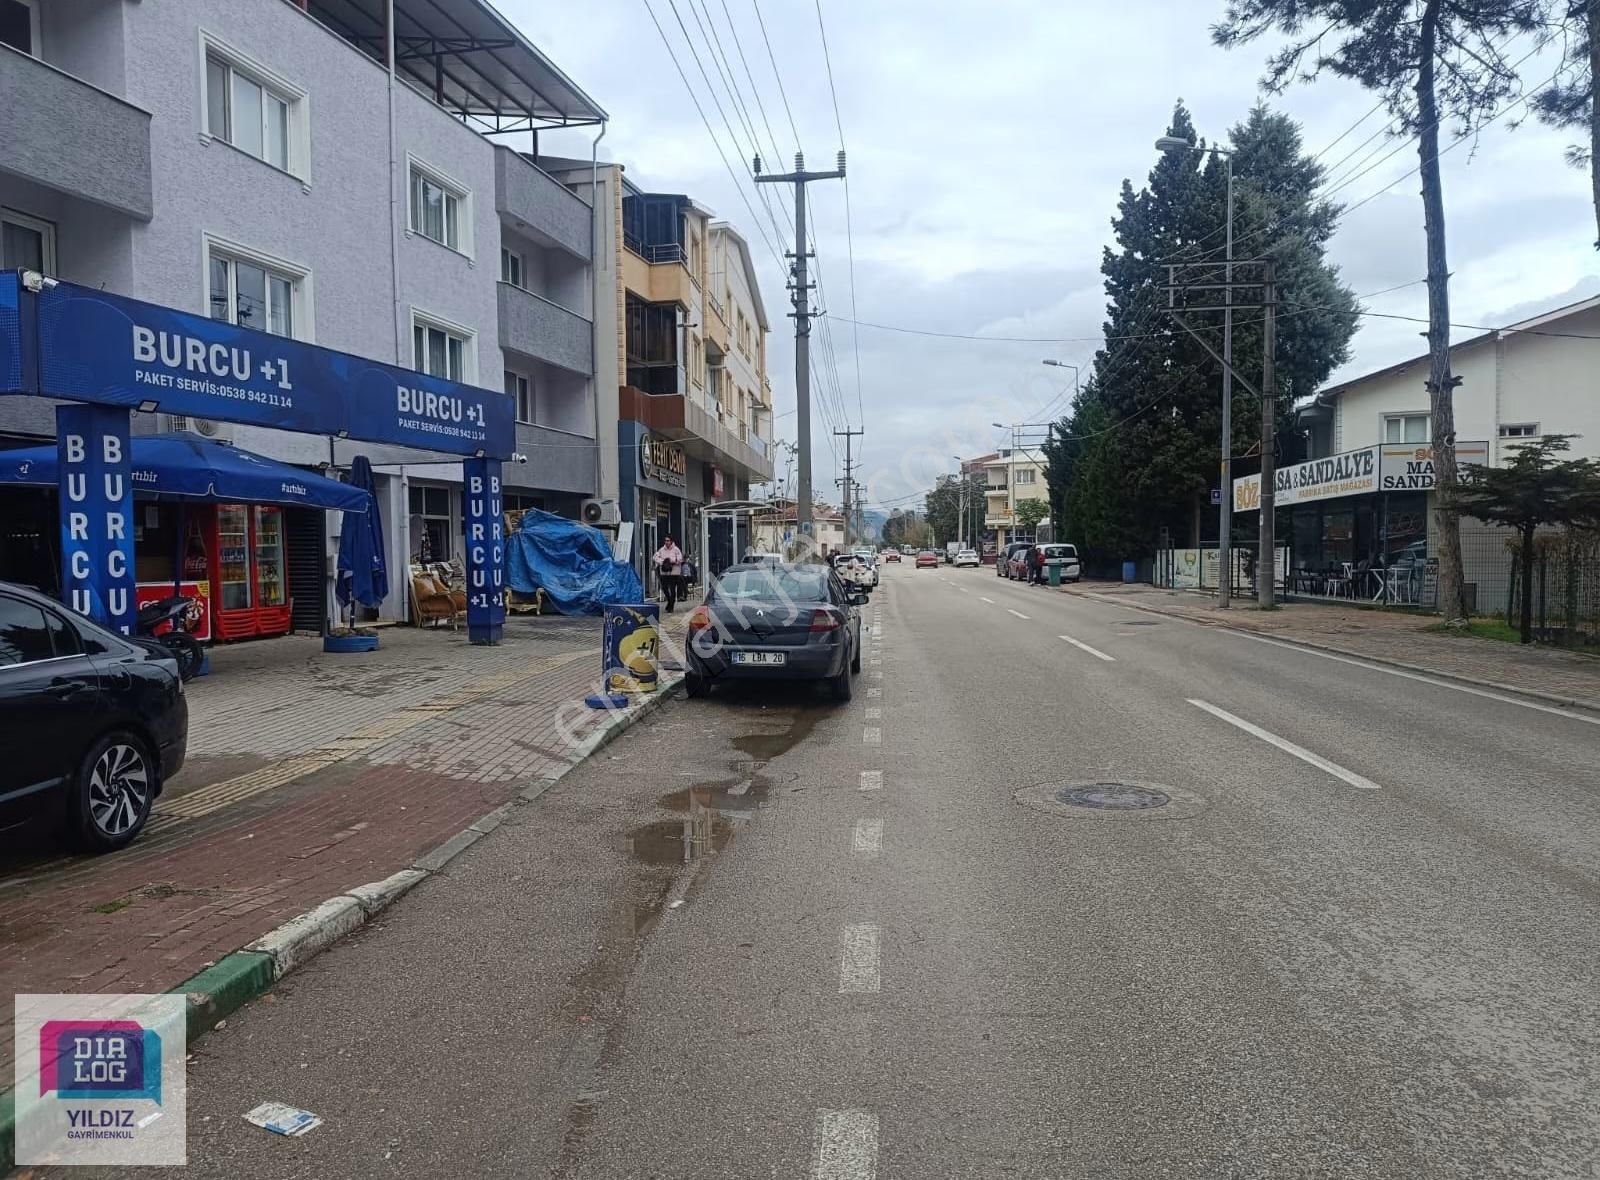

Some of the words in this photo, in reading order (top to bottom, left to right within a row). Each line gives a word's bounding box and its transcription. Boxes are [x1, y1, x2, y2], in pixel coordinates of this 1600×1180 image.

[133, 325, 250, 381] BURCU
[260, 358, 292, 390] +1
[135, 370, 174, 388] PAKET
[248, 391, 270, 403] 942
[269, 394, 282, 406] 11
[280, 396, 292, 408] 14
[397, 385, 462, 422] BURCU
[466, 403, 486, 427] +1
[399, 418, 419, 430] PAKET
[1274, 470, 1292, 491] SA
[1299, 450, 1374, 487] SANDALYE
[66, 435, 91, 616] BURCU
[103, 435, 127, 616] BURCU
[470, 476, 485, 587] BURCU
[491, 476, 502, 586] BURCU
[471, 593, 488, 607] +1
[492, 592, 503, 606] +1
[773, 653, 783, 662] 20
